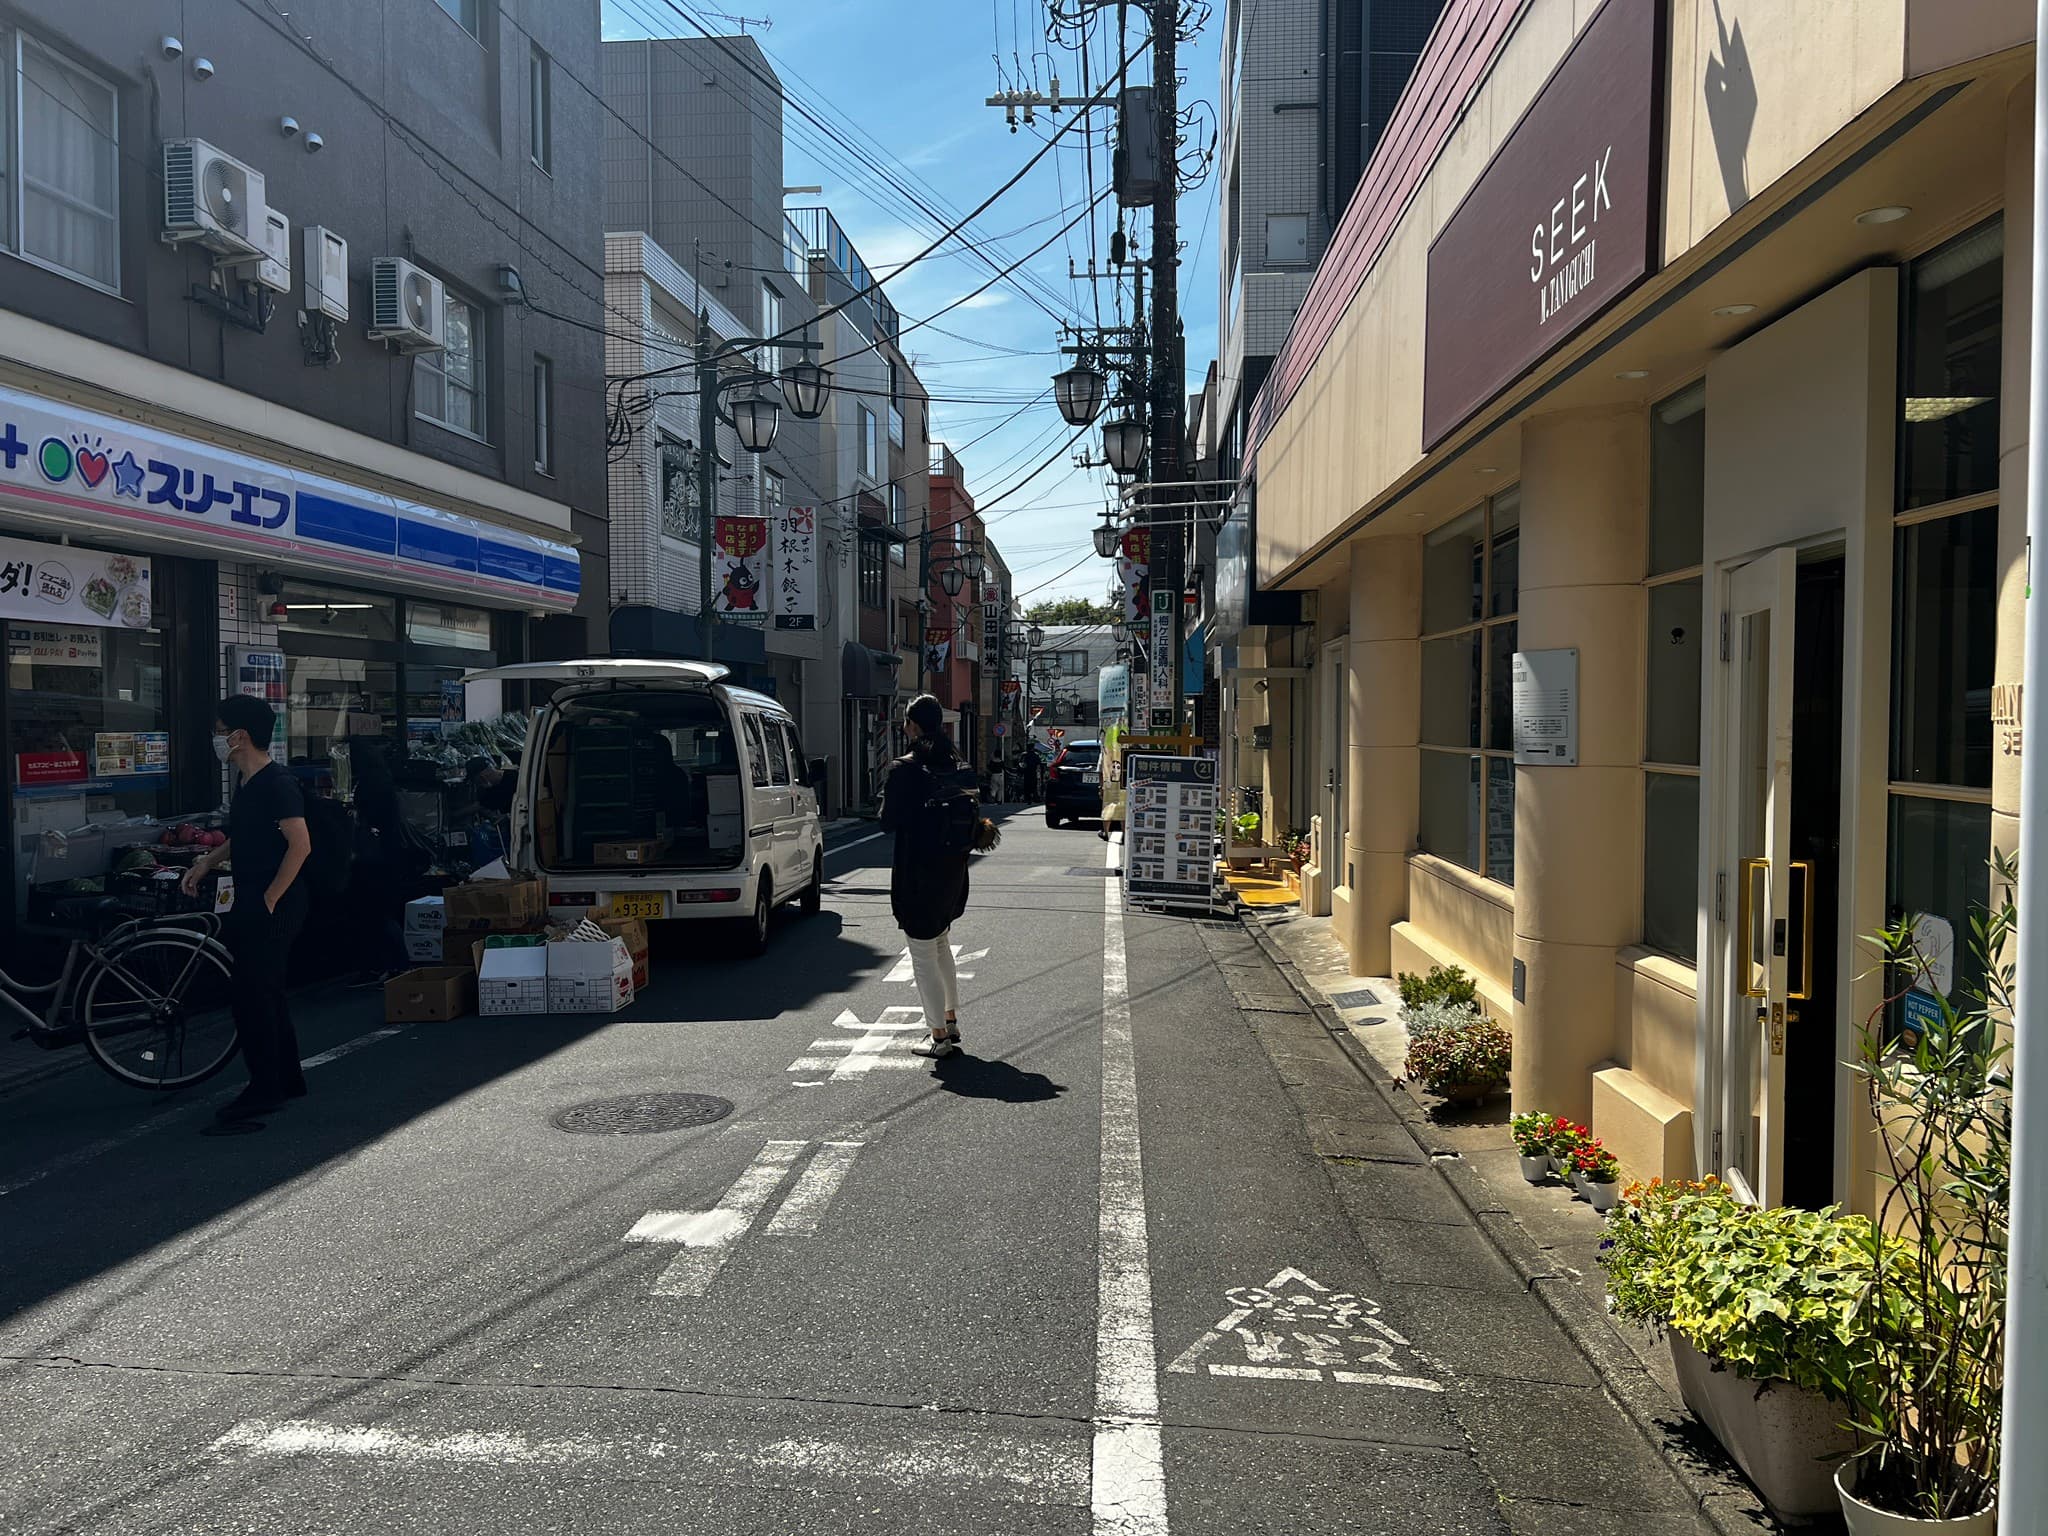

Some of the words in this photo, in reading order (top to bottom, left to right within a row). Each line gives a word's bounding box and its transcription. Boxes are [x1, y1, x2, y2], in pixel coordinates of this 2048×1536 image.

[1530, 144, 1612, 283] SEEK
[147, 459, 292, 530] スリーエフ
[778, 517, 801, 613] 羽根木餃子
[788, 617, 804, 628] 2F
[984, 604, 998, 667] 山田精米
[1199, 762, 1212, 775] 21
[623, 902, 661, 917] 93-33
[1918, 1003, 1939, 1019] PEPPER
